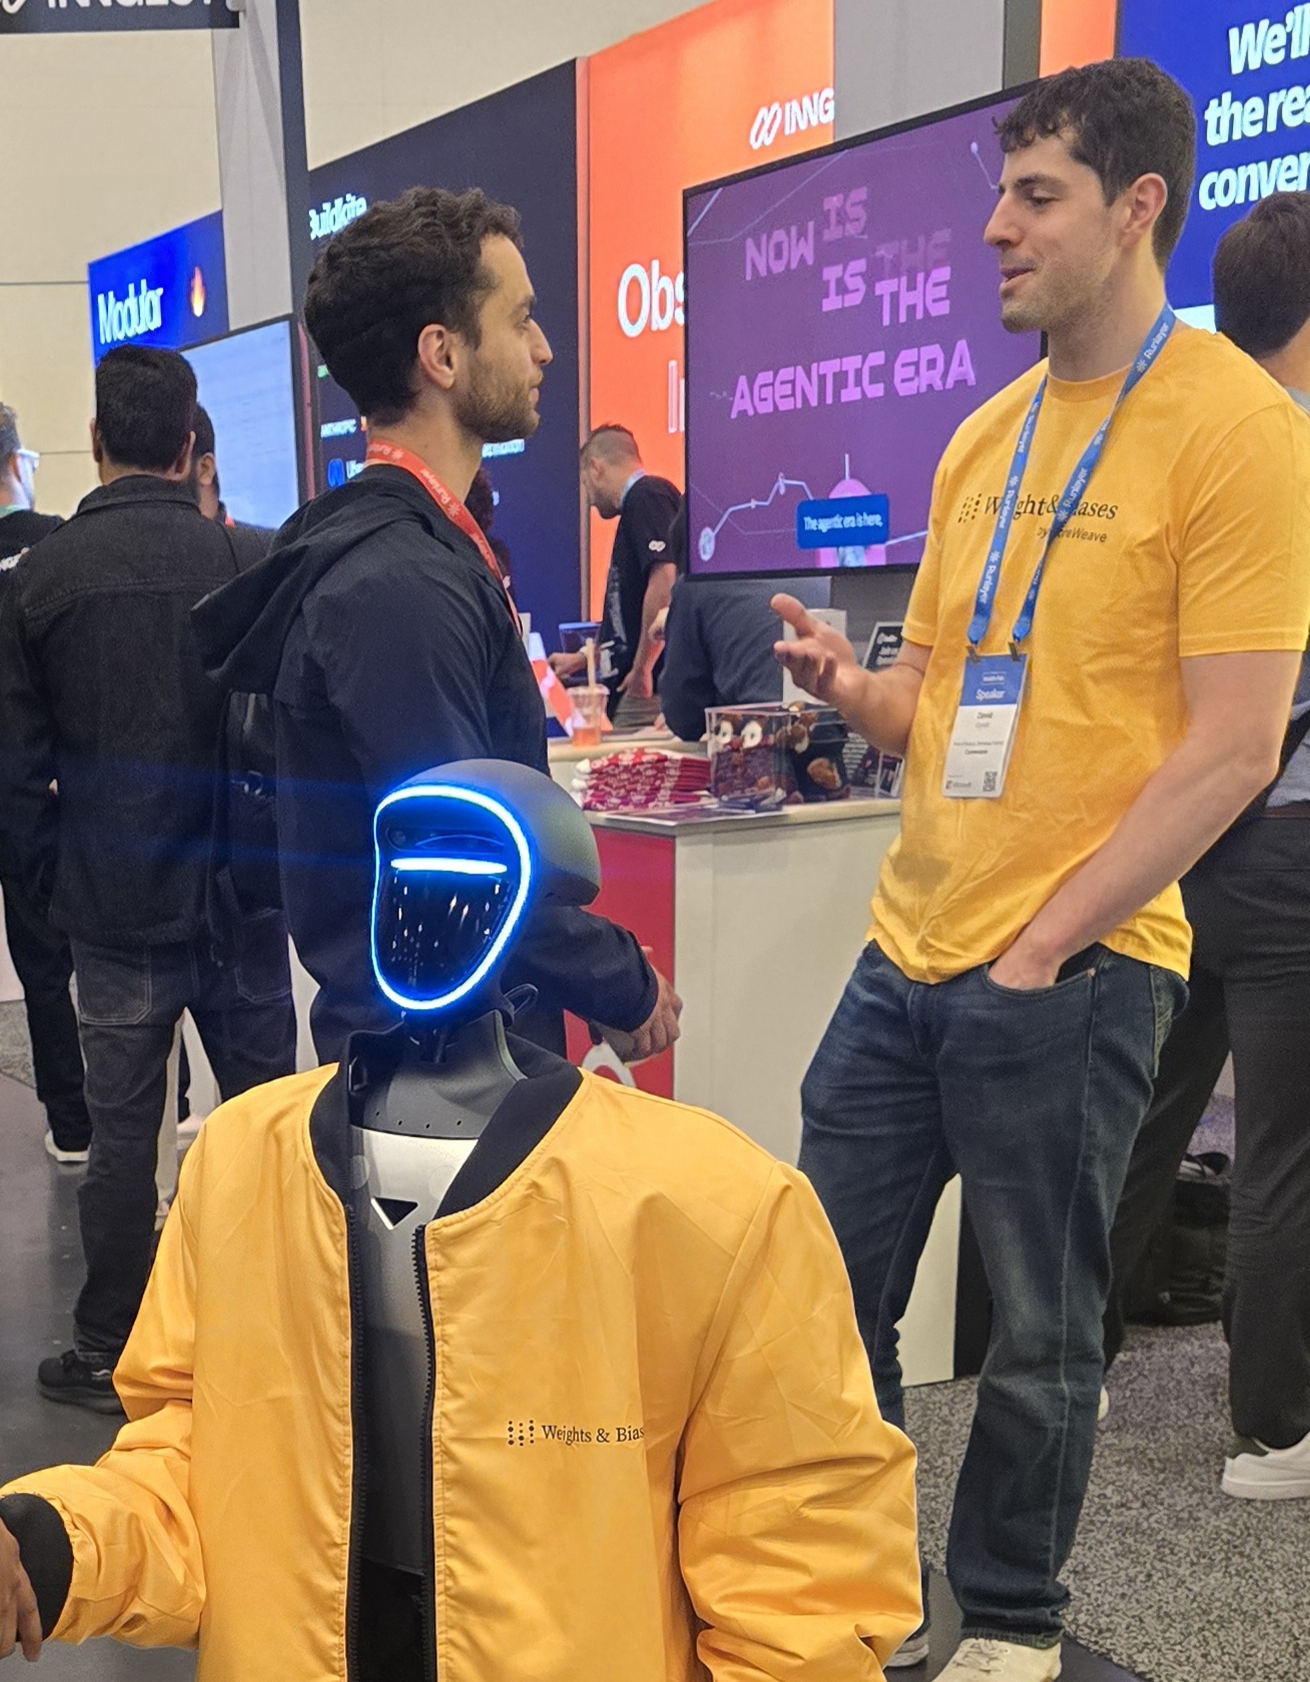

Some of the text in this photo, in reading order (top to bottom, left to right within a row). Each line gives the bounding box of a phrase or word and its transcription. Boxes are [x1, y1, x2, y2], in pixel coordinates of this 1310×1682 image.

[1204, 85, 1310, 146] the re
[745, 220, 952, 327] NOW IS THE
[97, 279, 164, 345] Modular
[1143, 321, 1170, 360] Runlayer
[730, 351, 886, 419] AGENTIC
[893, 339, 977, 397] ERA
[419, 468, 452, 505] Runlayer
[1063, 466, 1089, 508] Runlayer
[998, 489, 1016, 529] Runlayer
[978, 564, 997, 604] Runlayer
[541, 1425, 592, 1446] Weights
[596, 1427, 610, 1443] &
